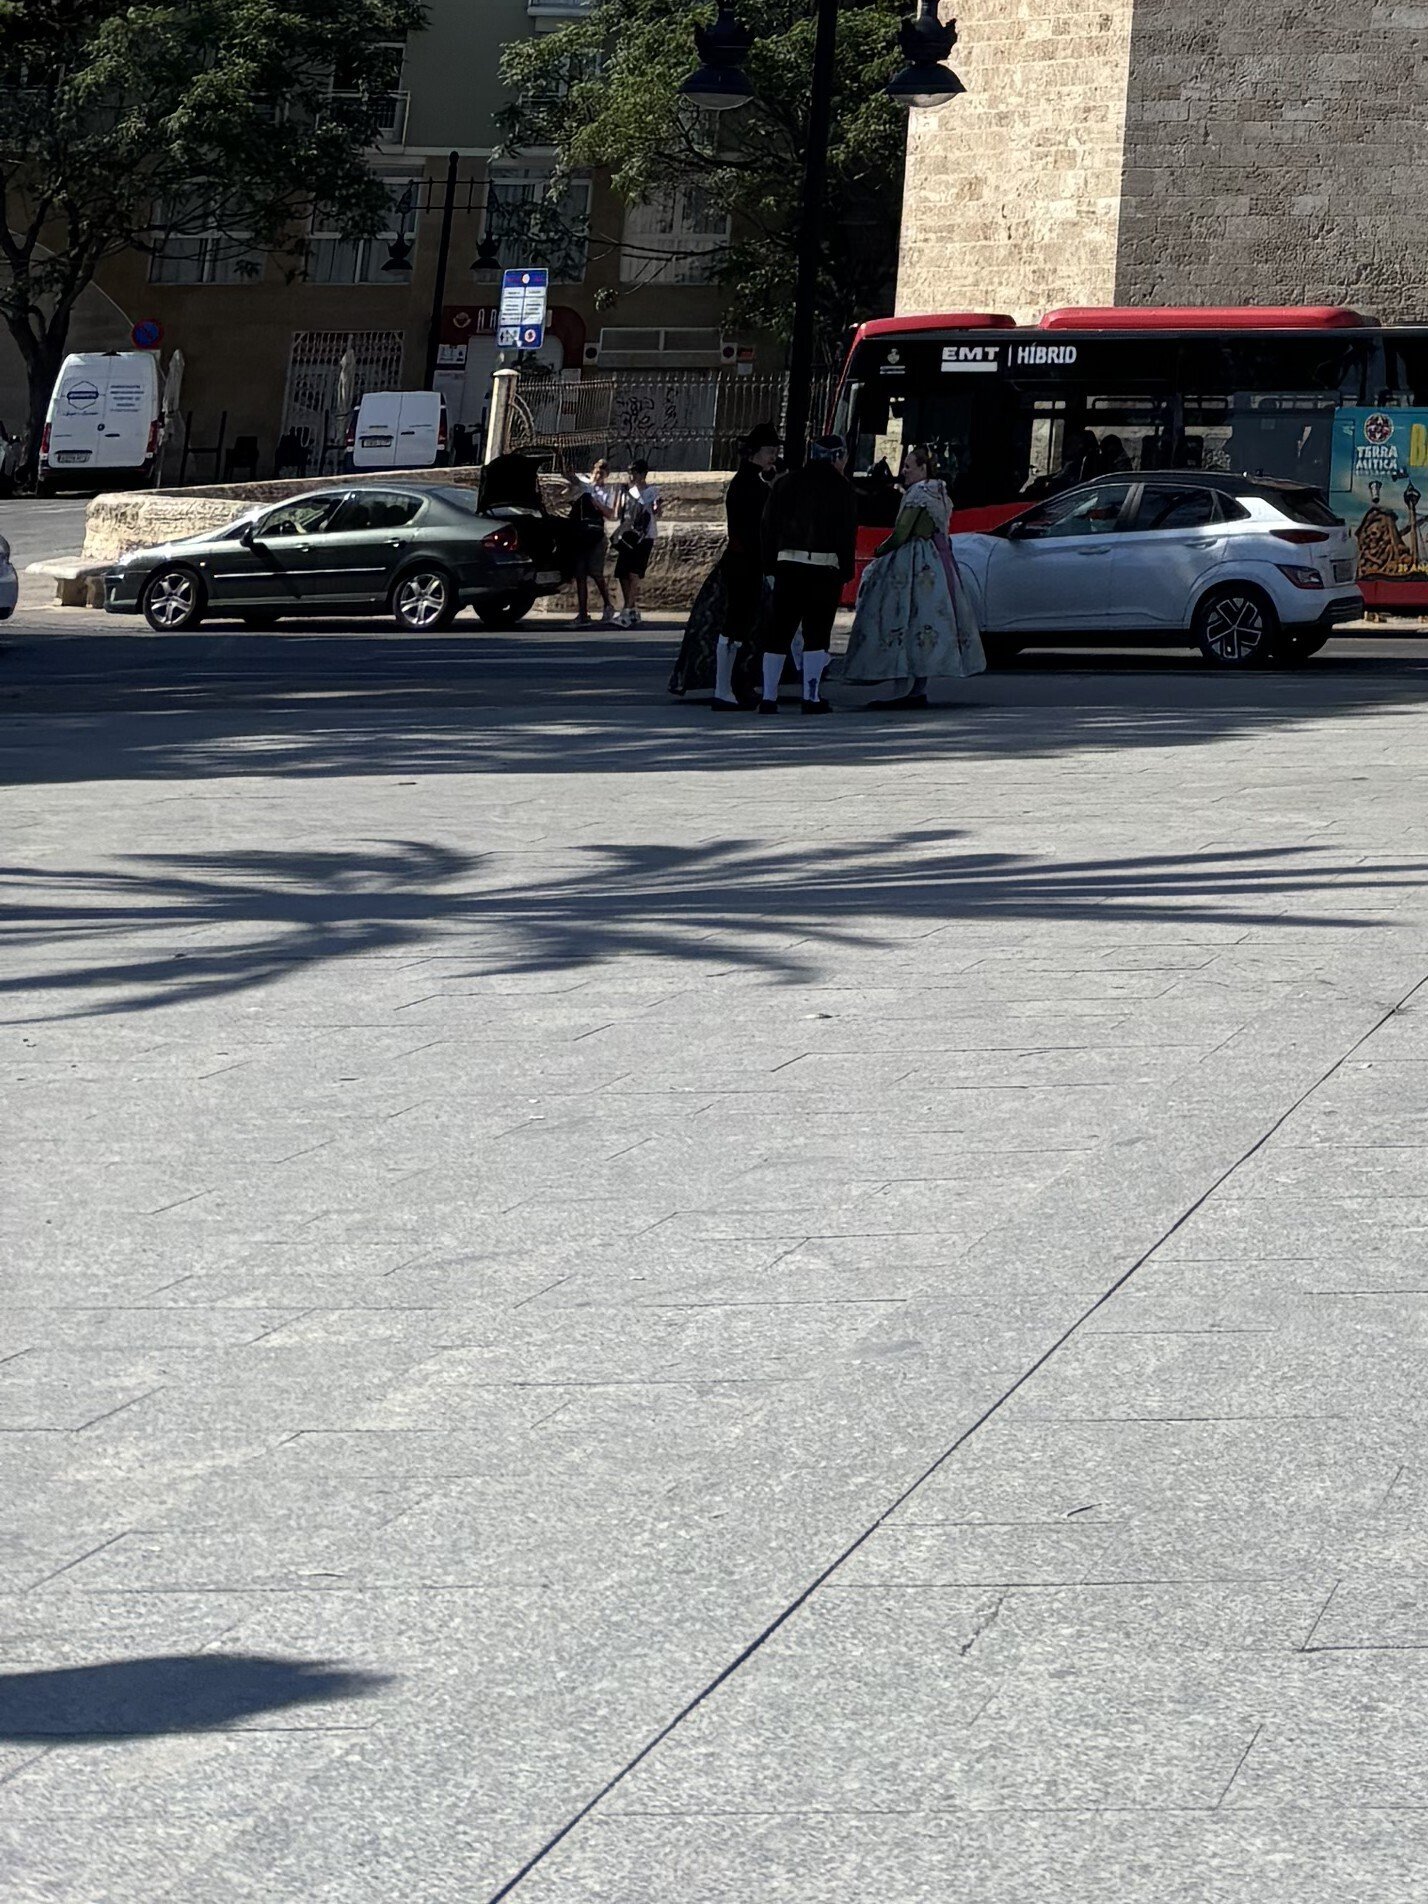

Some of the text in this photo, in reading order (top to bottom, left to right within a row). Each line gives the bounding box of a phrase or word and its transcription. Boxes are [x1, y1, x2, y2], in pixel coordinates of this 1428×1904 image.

[942, 342, 1078, 364] EMT HÍBRID
[1356, 445, 1398, 458] TERRA
